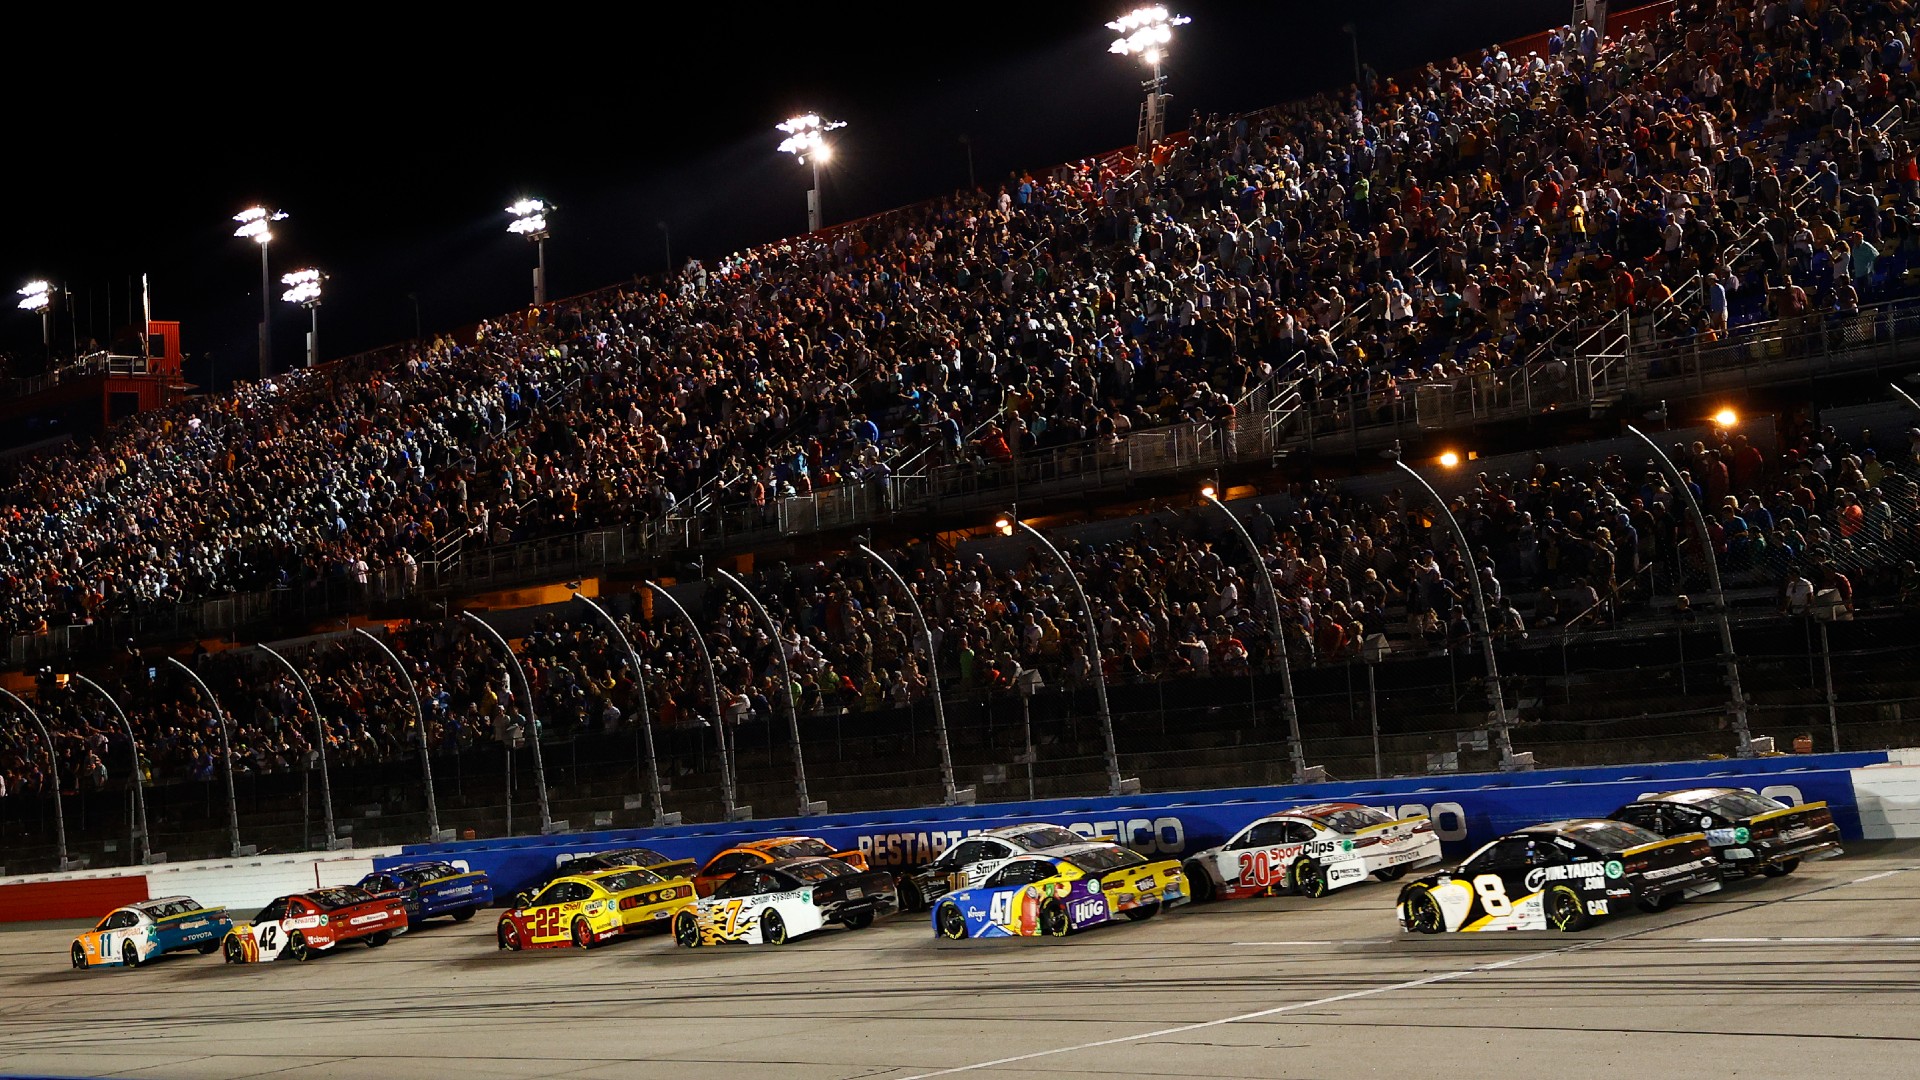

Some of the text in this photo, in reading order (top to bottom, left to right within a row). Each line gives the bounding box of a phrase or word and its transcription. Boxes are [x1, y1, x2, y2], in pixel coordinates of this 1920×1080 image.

[858, 829, 962, 865] RESTART
[1069, 816, 1186, 855] GEICO
[975, 860, 1000, 875] Smit
[1239, 849, 1270, 887] 20
[1395, 851, 1420, 863] TOYOTA
[947, 871, 969, 892] 10
[584, 900, 603, 912] PENNZOIL
[1472, 873, 1514, 917] 8
[562, 902, 582, 912] Shell
[724, 899, 743, 937] 7
[967, 906, 986, 922] Kroger
[990, 890, 1014, 925] 47
[1075, 900, 1104, 923] HUG
[1587, 899, 1609, 916] CAT
[535, 907, 560, 938] 22
[100, 933, 111, 957] 11
[187, 931, 212, 941] TOYOTA
[260, 925, 277, 951] 42
[313, 935, 330, 943] clover
